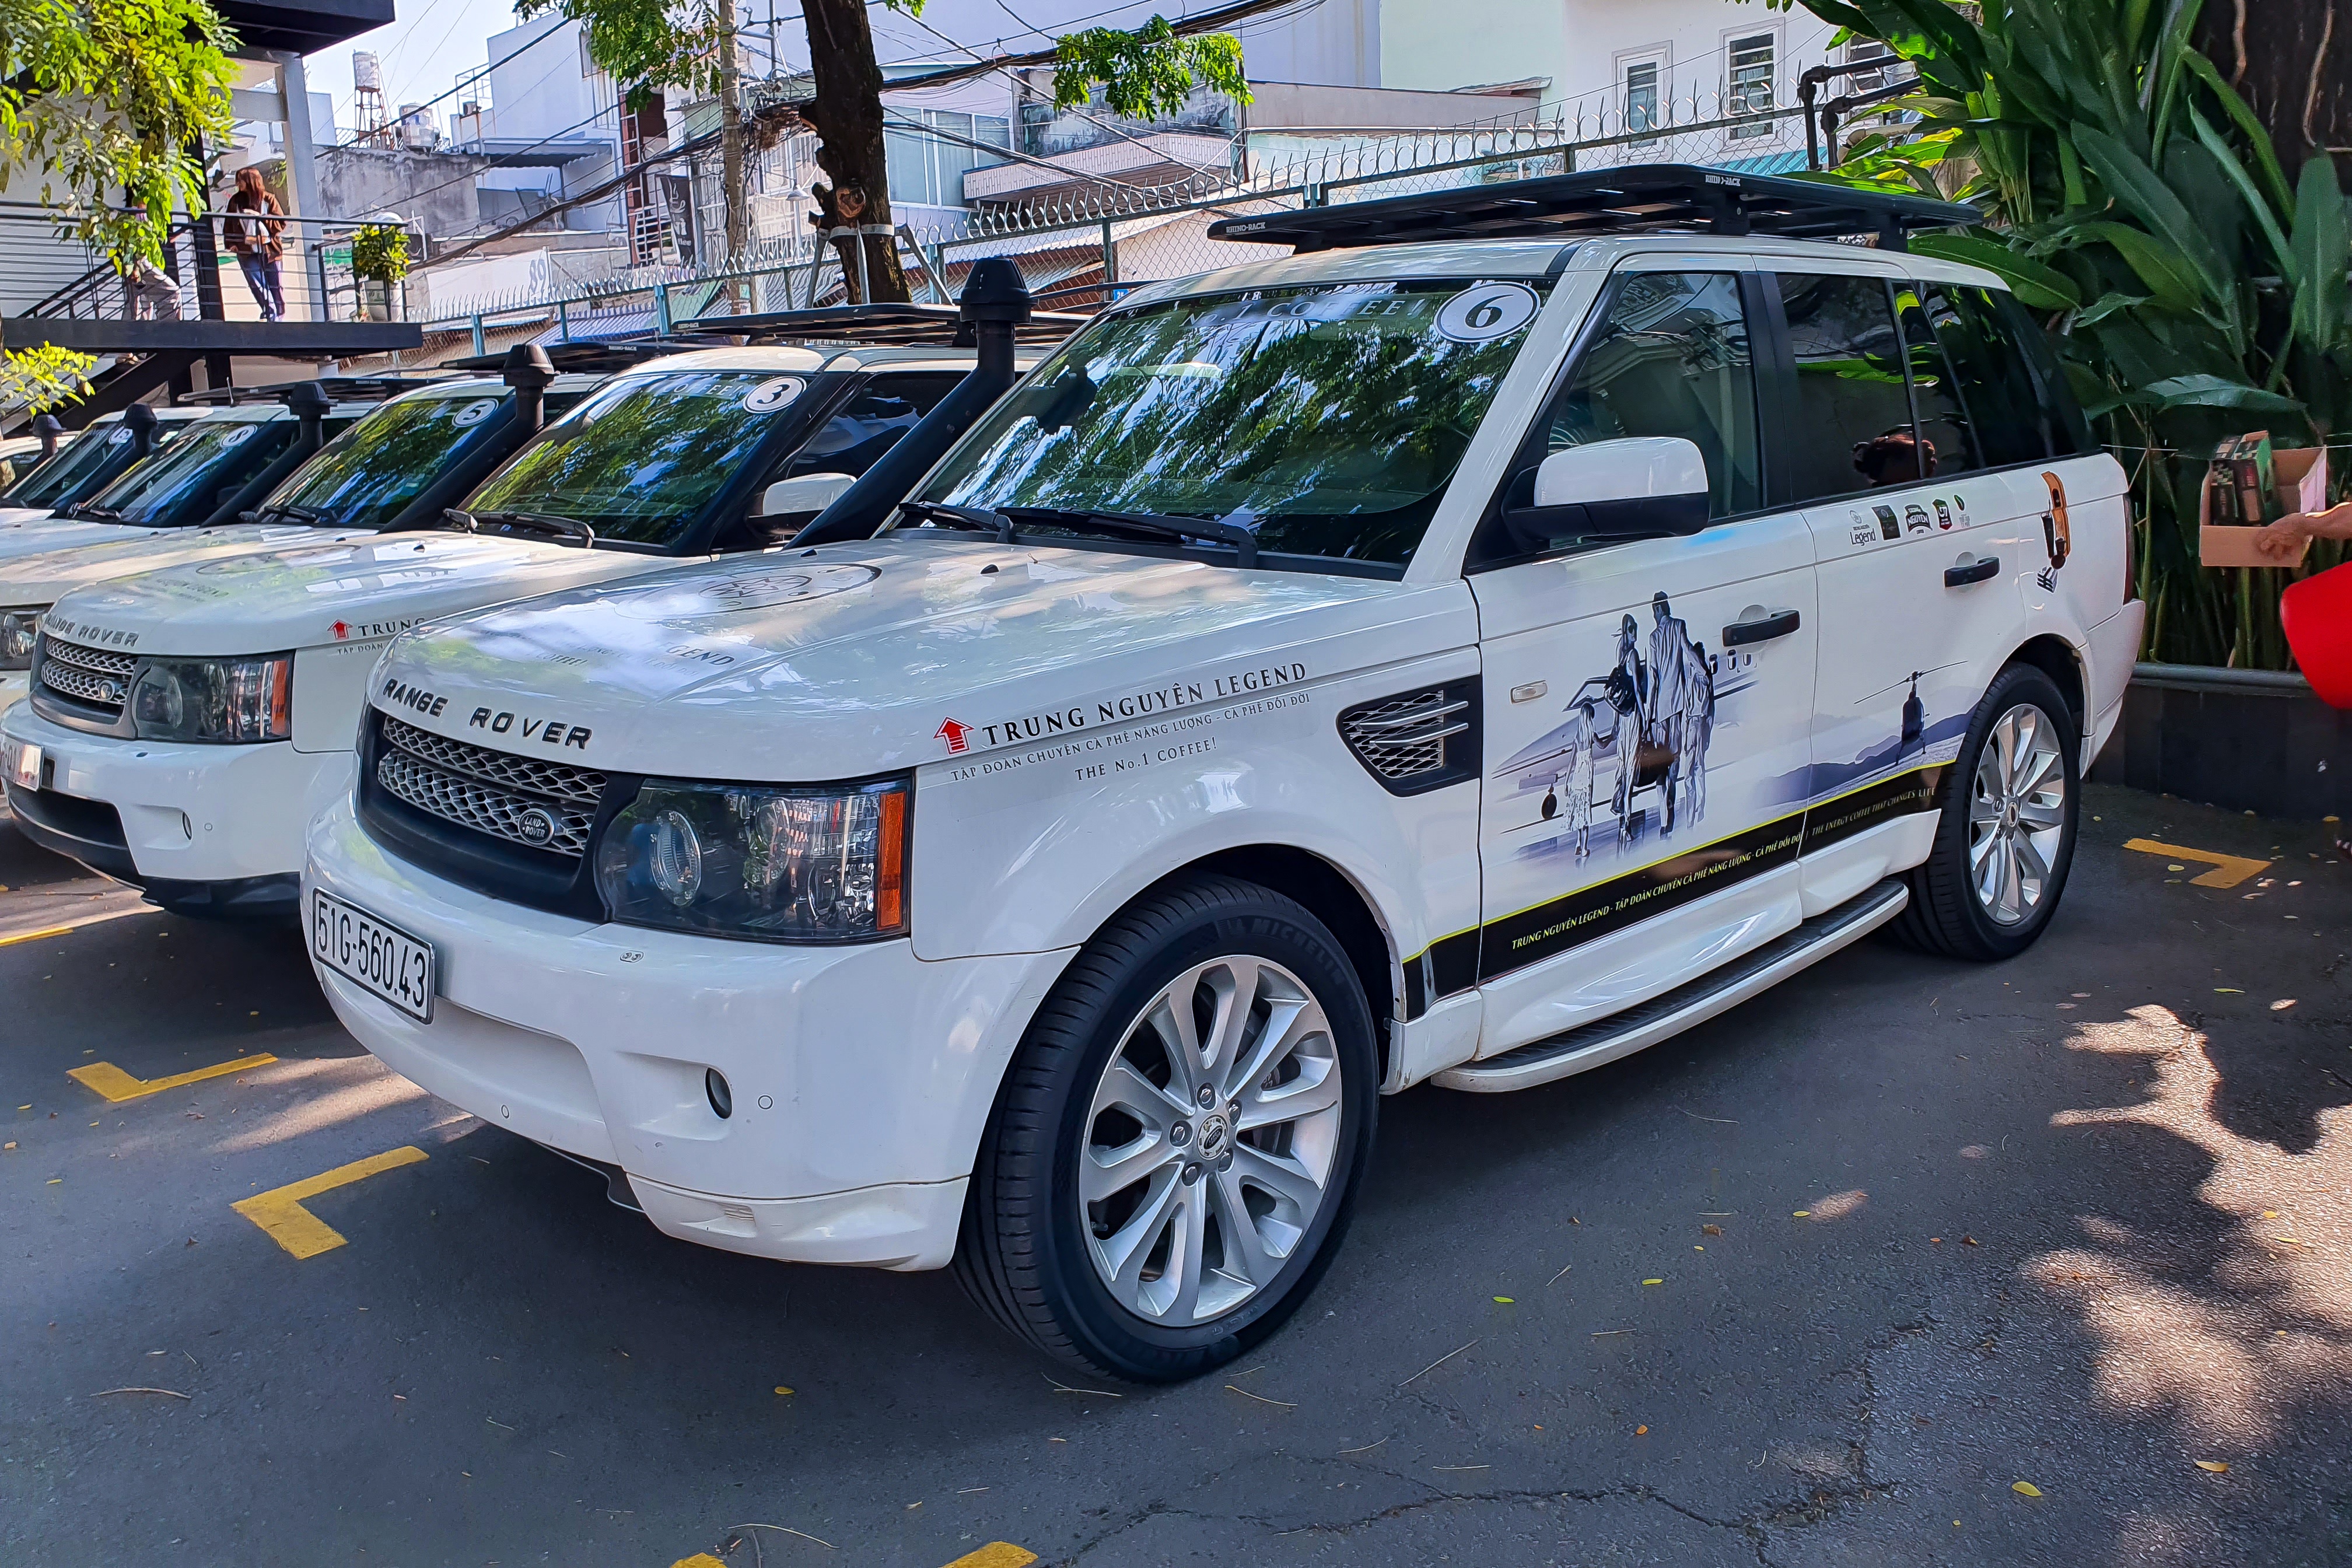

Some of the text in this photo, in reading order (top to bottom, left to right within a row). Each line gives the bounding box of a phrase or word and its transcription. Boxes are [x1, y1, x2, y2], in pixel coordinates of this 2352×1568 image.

[1226, 222, 1266, 233] RHINO-RACK
[1120, 317, 1172, 337] THE
[1266, 298, 1426, 318] COFFEE!
[1465, 294, 1515, 330] 6
[462, 403, 489, 421] 5
[756, 383, 790, 405] 3
[1849, 528, 1877, 547] Legend
[78, 625, 139, 648] ROVER
[382, 677, 593, 750] RANGE ROVER
[982, 663, 1306, 746] TRUNG NGUYÊN LEGEND
[950, 766, 977, 782] TẬP
[982, 757, 1022, 775] ĐOÀN
[1026, 743, 1081, 764] CHUYÊN
[1086, 737, 1103, 751] CÀ
[1106, 730, 1130, 747] PHÊ
[1133, 724, 1168, 741] NĂNG
[1172, 714, 1212, 732] LƯỢNG
[1224, 708, 1240, 720] CÀ
[1241, 702, 1263, 717] PHÊ
[1266, 696, 1287, 711] ĐỔI
[1290, 692, 1310, 706] ĐỜI
[1074, 736, 1217, 781] THE No.1 COFFEE!
[524, 816, 541, 827] LAND
[525, 825, 545, 838] ROVER
[1512, 930, 1542, 950] TRUNG
[1543, 917, 1577, 939] NGUYÊN
[1578, 905, 1609, 925] LEGEND
[318, 898, 427, 1009] 51G-560.43
[1251, 917, 1343, 985] MICHELIN
